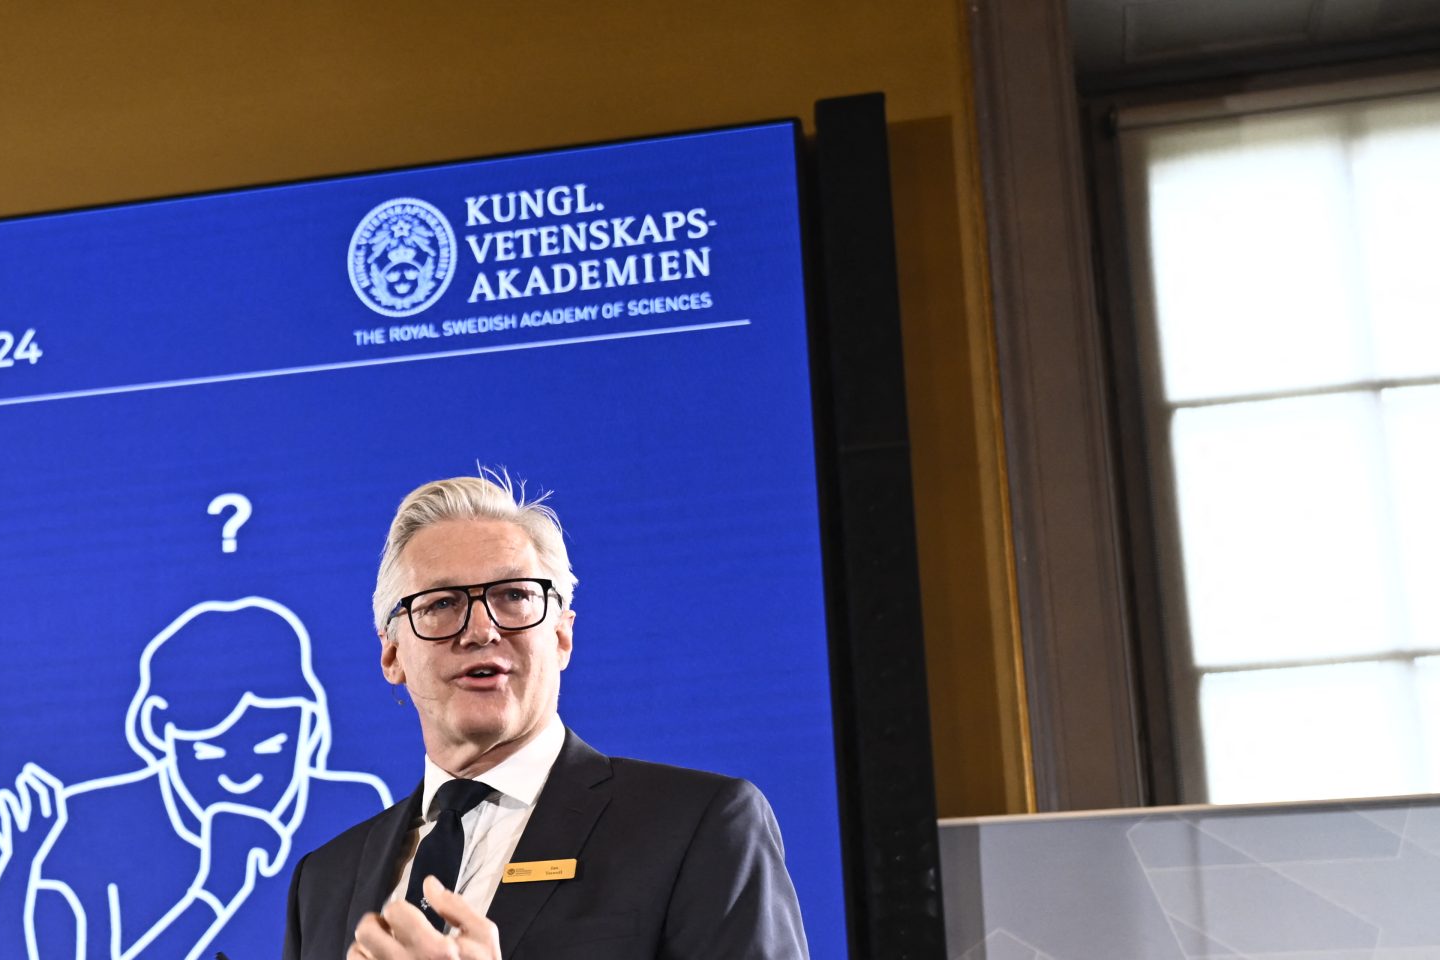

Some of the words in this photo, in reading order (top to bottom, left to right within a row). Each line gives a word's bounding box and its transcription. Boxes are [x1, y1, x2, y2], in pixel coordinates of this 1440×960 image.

[465, 184, 604, 226] KUNGL.
[465, 207, 717, 264] VETENSKAPS-
[467, 246, 712, 303] AKADEMIEN
[354, 330, 386, 346] THE
[389, 324, 439, 343] ROYAL
[442, 316, 517, 336] SWEDISH
[520, 304, 598, 329] ACADEMY
[602, 302, 623, 319] OF
[627, 292, 713, 316] SCIENCES
[207, 493, 252, 553] ?
